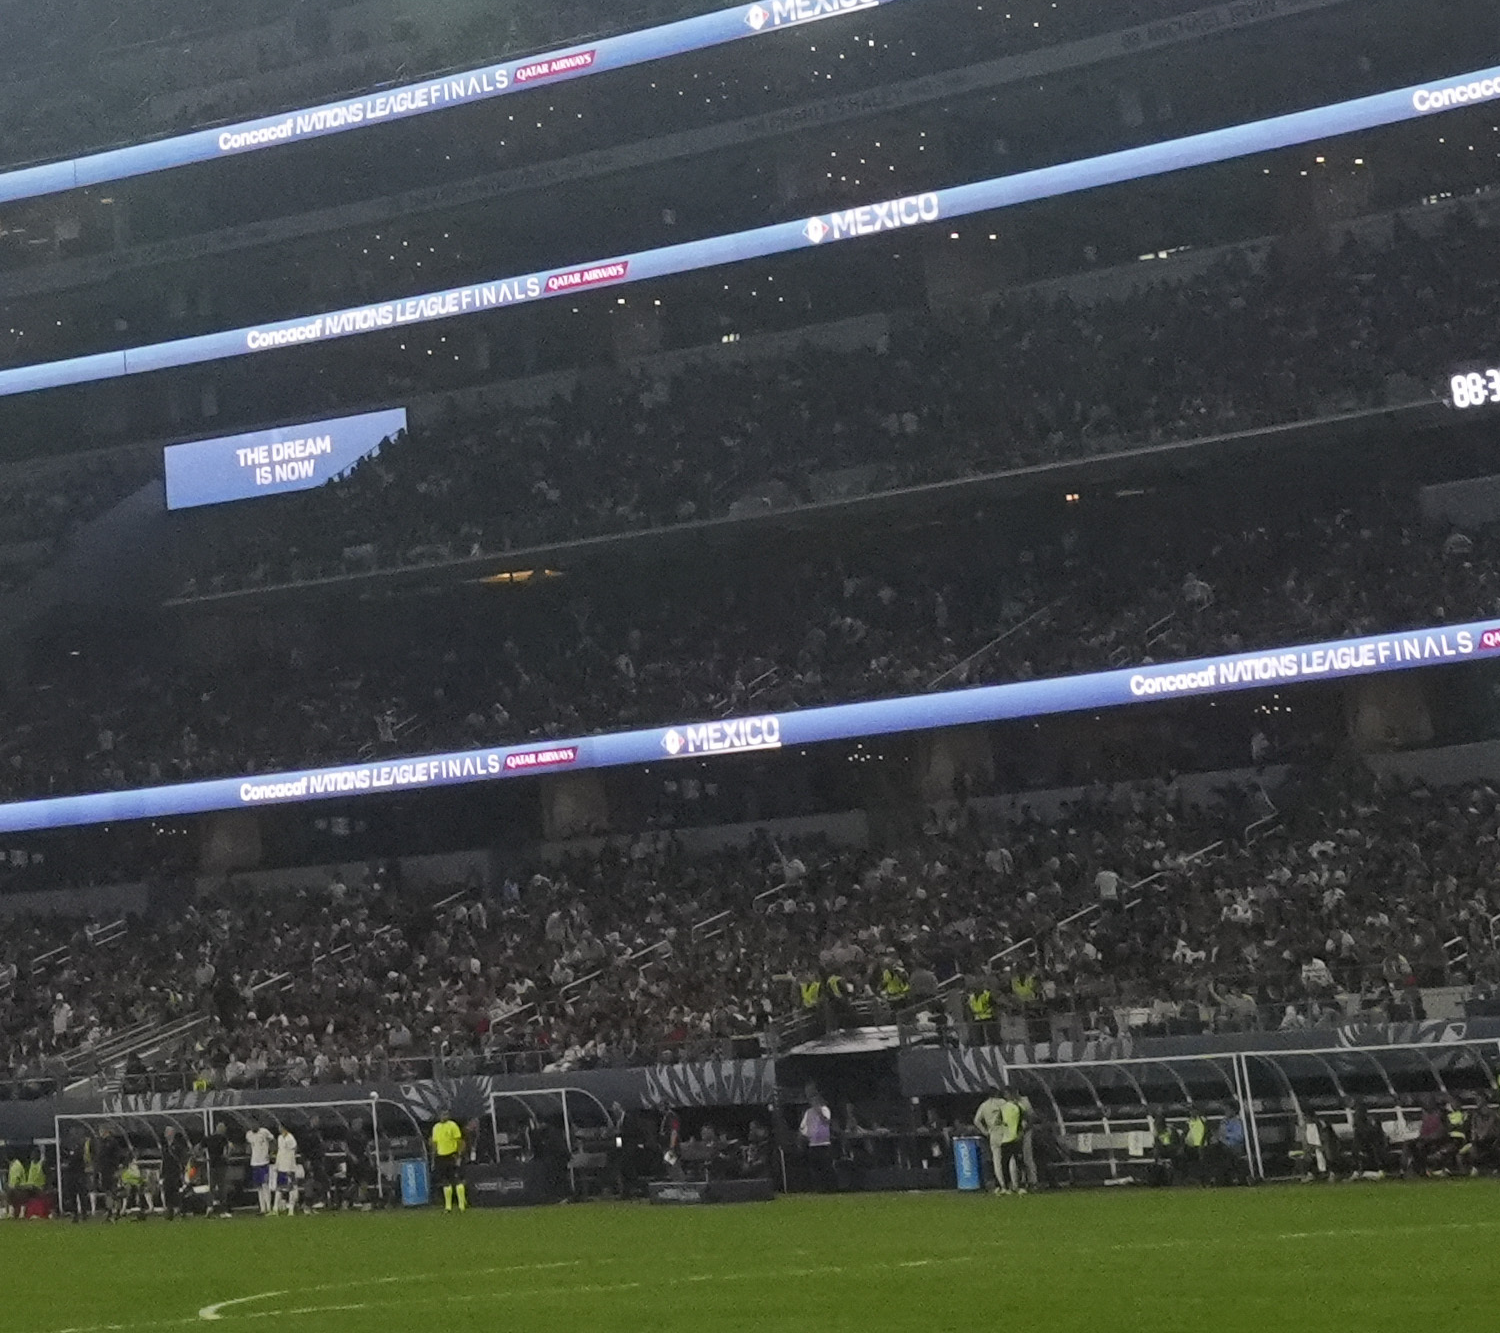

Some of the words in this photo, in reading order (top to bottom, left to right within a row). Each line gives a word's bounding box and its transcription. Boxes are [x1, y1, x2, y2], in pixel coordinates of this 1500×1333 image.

[236, 445, 269, 467] THE
[271, 435, 331, 462] DREAM
[255, 466, 273, 485] IS
[275, 459, 315, 483] NOW
